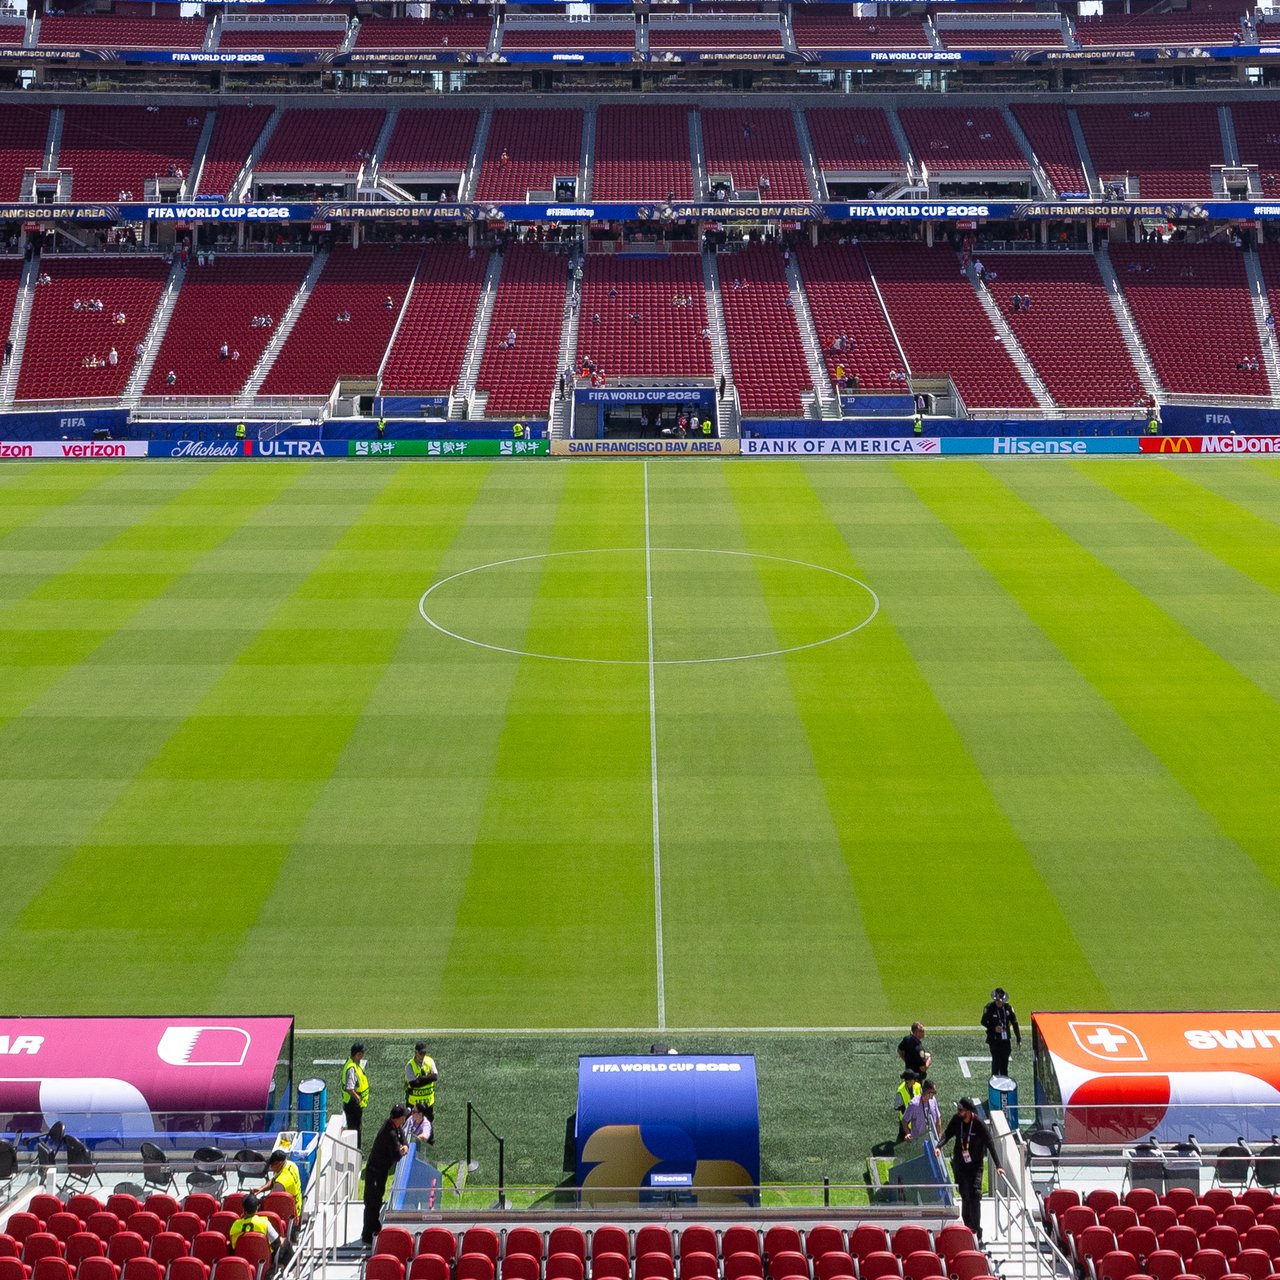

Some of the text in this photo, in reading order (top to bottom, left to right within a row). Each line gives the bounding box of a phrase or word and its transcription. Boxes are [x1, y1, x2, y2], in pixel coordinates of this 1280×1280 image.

[53, 209, 75, 217] BAY
[77, 208, 106, 217] AREA
[148, 208, 289, 217] FIFA WORLD CUP 2026
[679, 207, 810, 216] SAN FRANCISCO BAY AREA
[850, 207, 989, 216] FIFA WORLD CUP 2026
[589, 391, 700, 400] FIFA WORLD CUP 2026
[61, 418, 86, 428] FIFA
[1205, 414, 1231, 424] FIFA
[62, 442, 126, 458] verizon
[171, 440, 325, 457] Michelob ULTRA
[569, 442, 721, 452] SAN FRANCISCO BAY AREA
[748, 440, 913, 453] BANK OF AMERICA
[993, 437, 1087, 454] Hisense
[592, 1063, 741, 1072] FIFA WORLD CUP 2026
